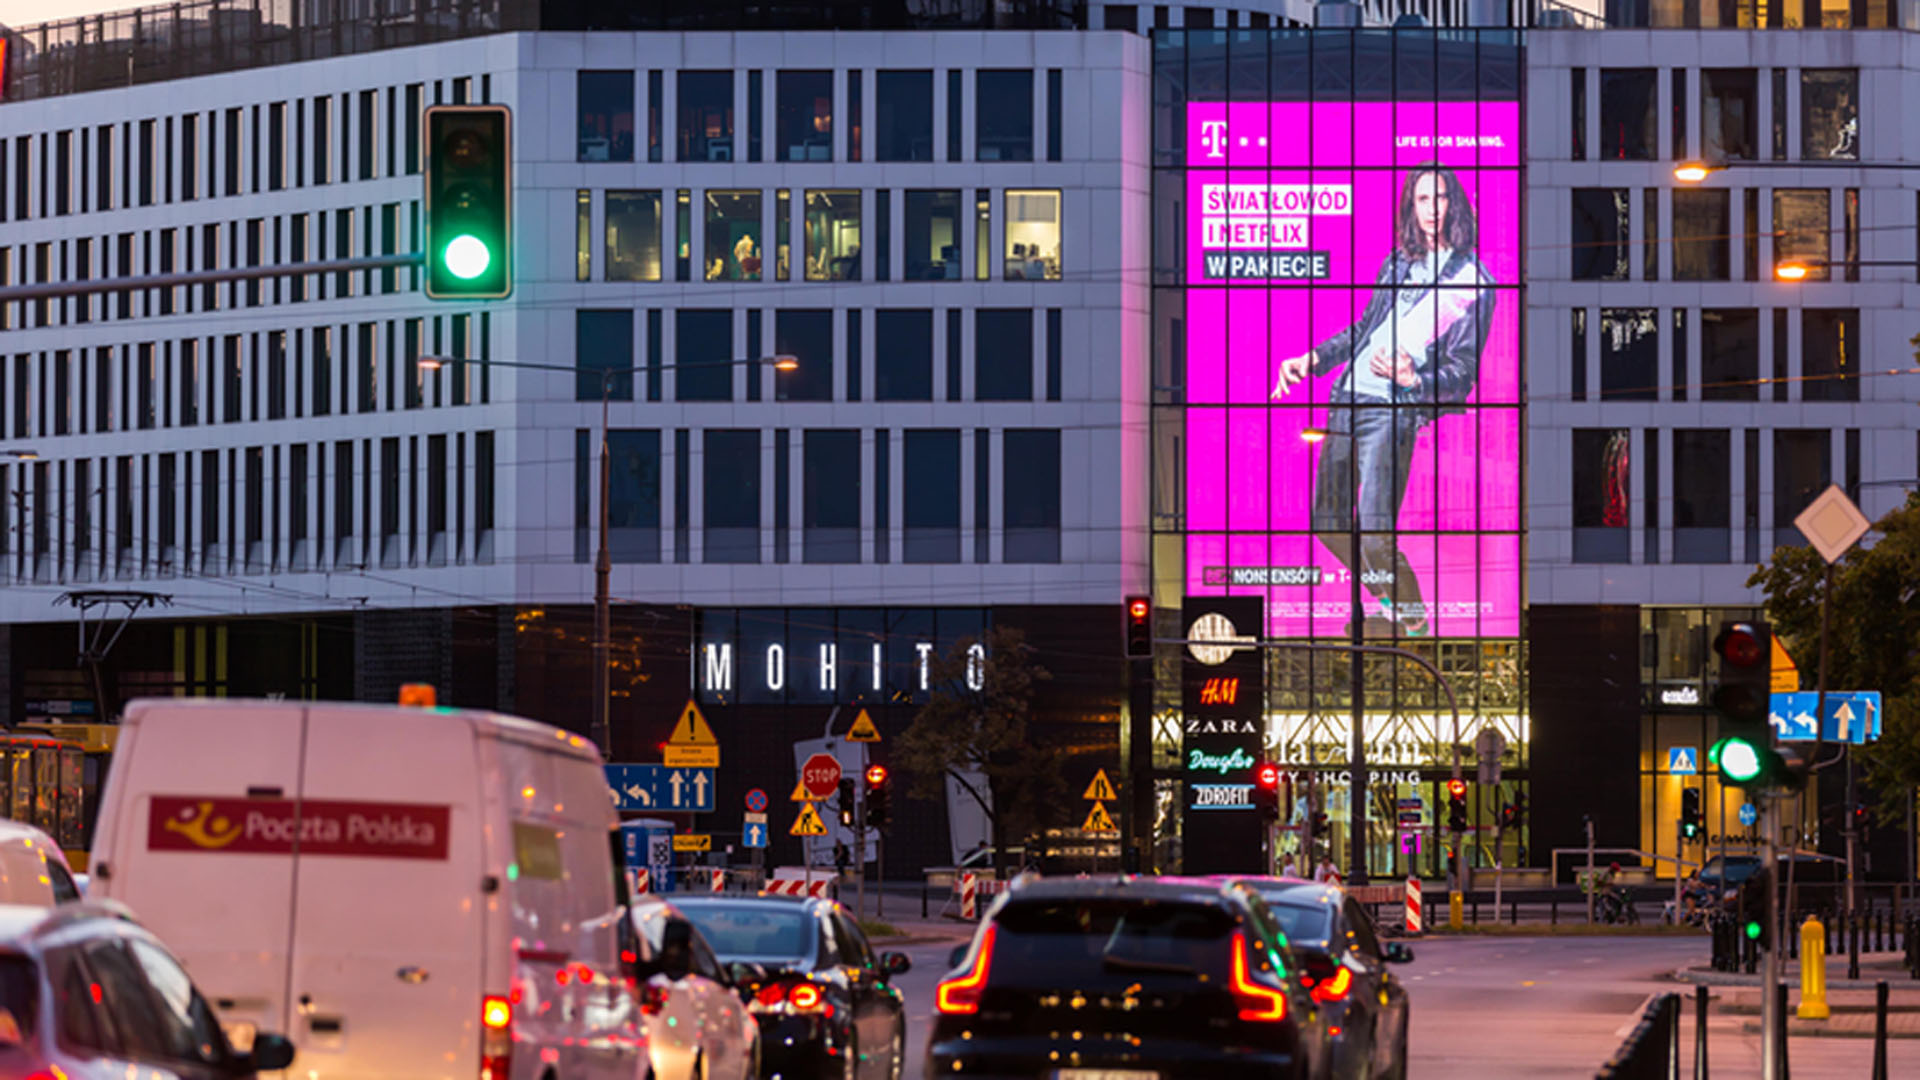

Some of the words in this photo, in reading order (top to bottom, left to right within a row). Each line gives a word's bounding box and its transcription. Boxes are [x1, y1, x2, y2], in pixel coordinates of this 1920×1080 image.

[1396, 136, 1418, 148] LIFE
[1420, 136, 1431, 148] IS
[1208, 186, 1348, 211] ŚWIATŁOWÓD
[1208, 223, 1214, 243] I
[1218, 223, 1303, 243] NETFLIX
[1207, 256, 1227, 277] W
[1230, 256, 1325, 277] PAKIECIE
[1337, 569, 1395, 584] T-obile
[706, 643, 985, 691] MOHITO
[1186, 719, 1257, 734] ZARA
[806, 767, 839, 784] STOP
[246, 811, 341, 843] Poczta
[348, 813, 436, 845] Polska
